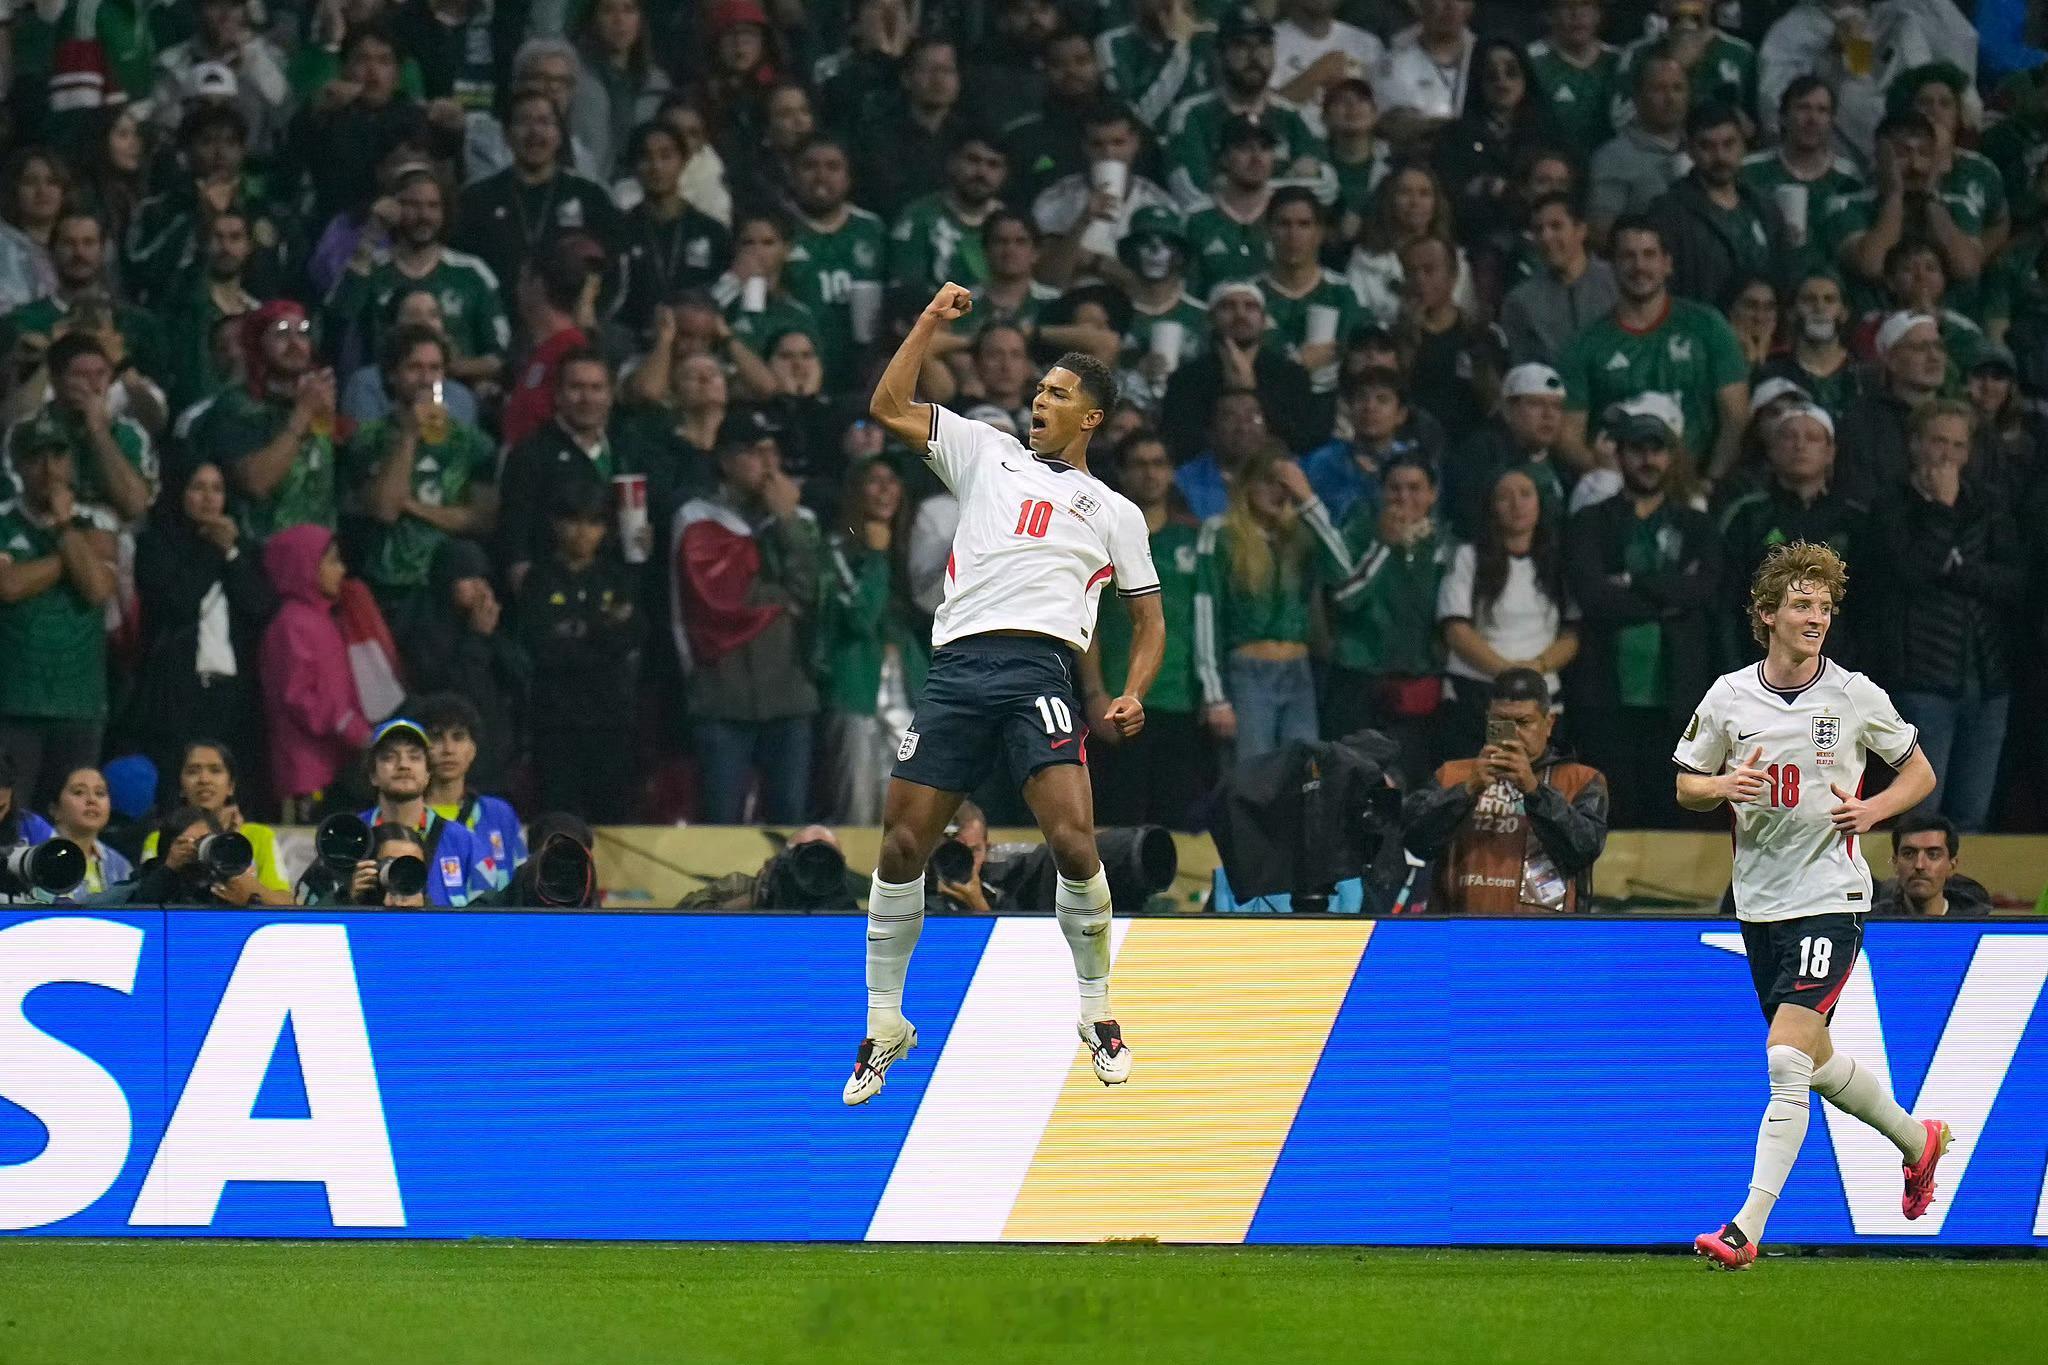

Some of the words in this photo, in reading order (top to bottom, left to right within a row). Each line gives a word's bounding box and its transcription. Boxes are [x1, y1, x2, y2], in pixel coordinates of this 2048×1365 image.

[1014, 499, 1054, 538] 10
[1034, 695, 1073, 735] 10
[1767, 763, 1800, 808] 18
[1798, 936, 1833, 979] 18
